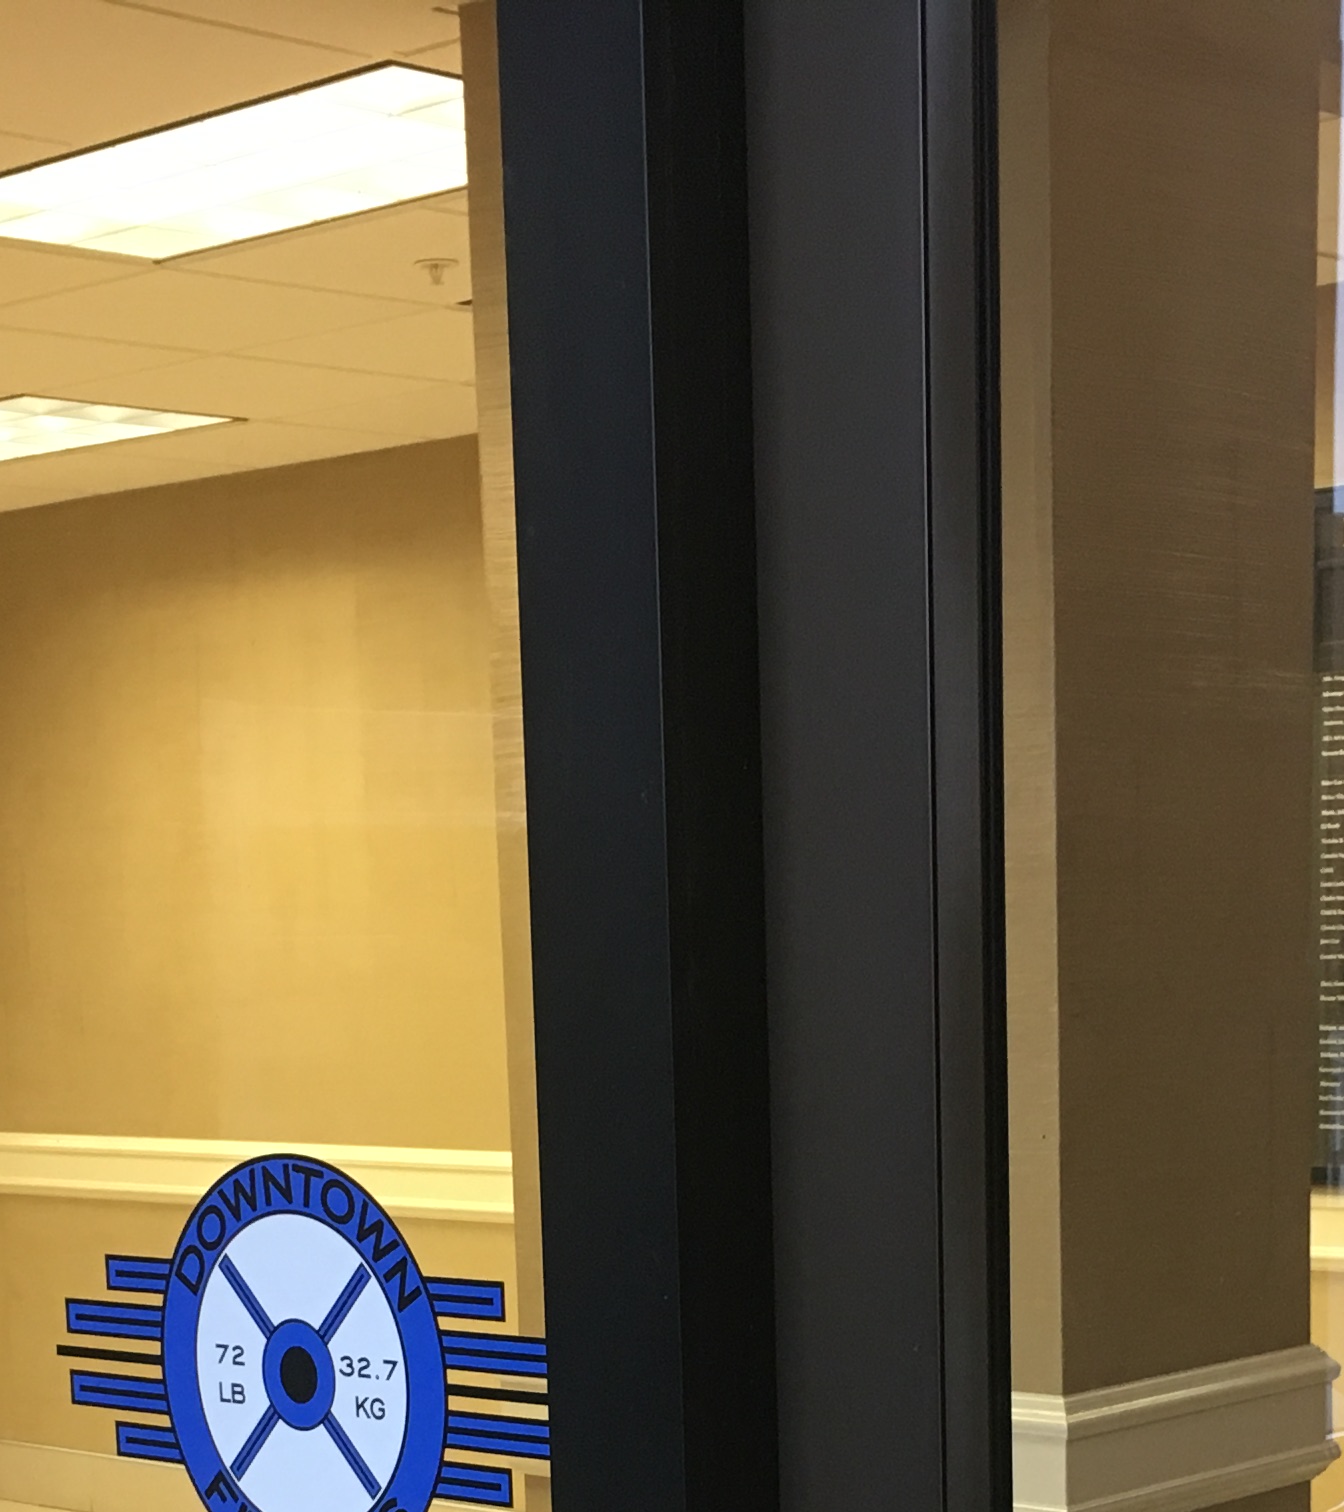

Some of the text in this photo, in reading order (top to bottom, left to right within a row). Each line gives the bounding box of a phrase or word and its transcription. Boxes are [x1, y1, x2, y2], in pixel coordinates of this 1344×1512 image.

[174, 1163, 424, 1314] DOWNTOWN
[214, 1343, 246, 1366] 72
[339, 1356, 398, 1381] 32.7
[218, 1382, 246, 1404] LB
[355, 1396, 386, 1421] KG
